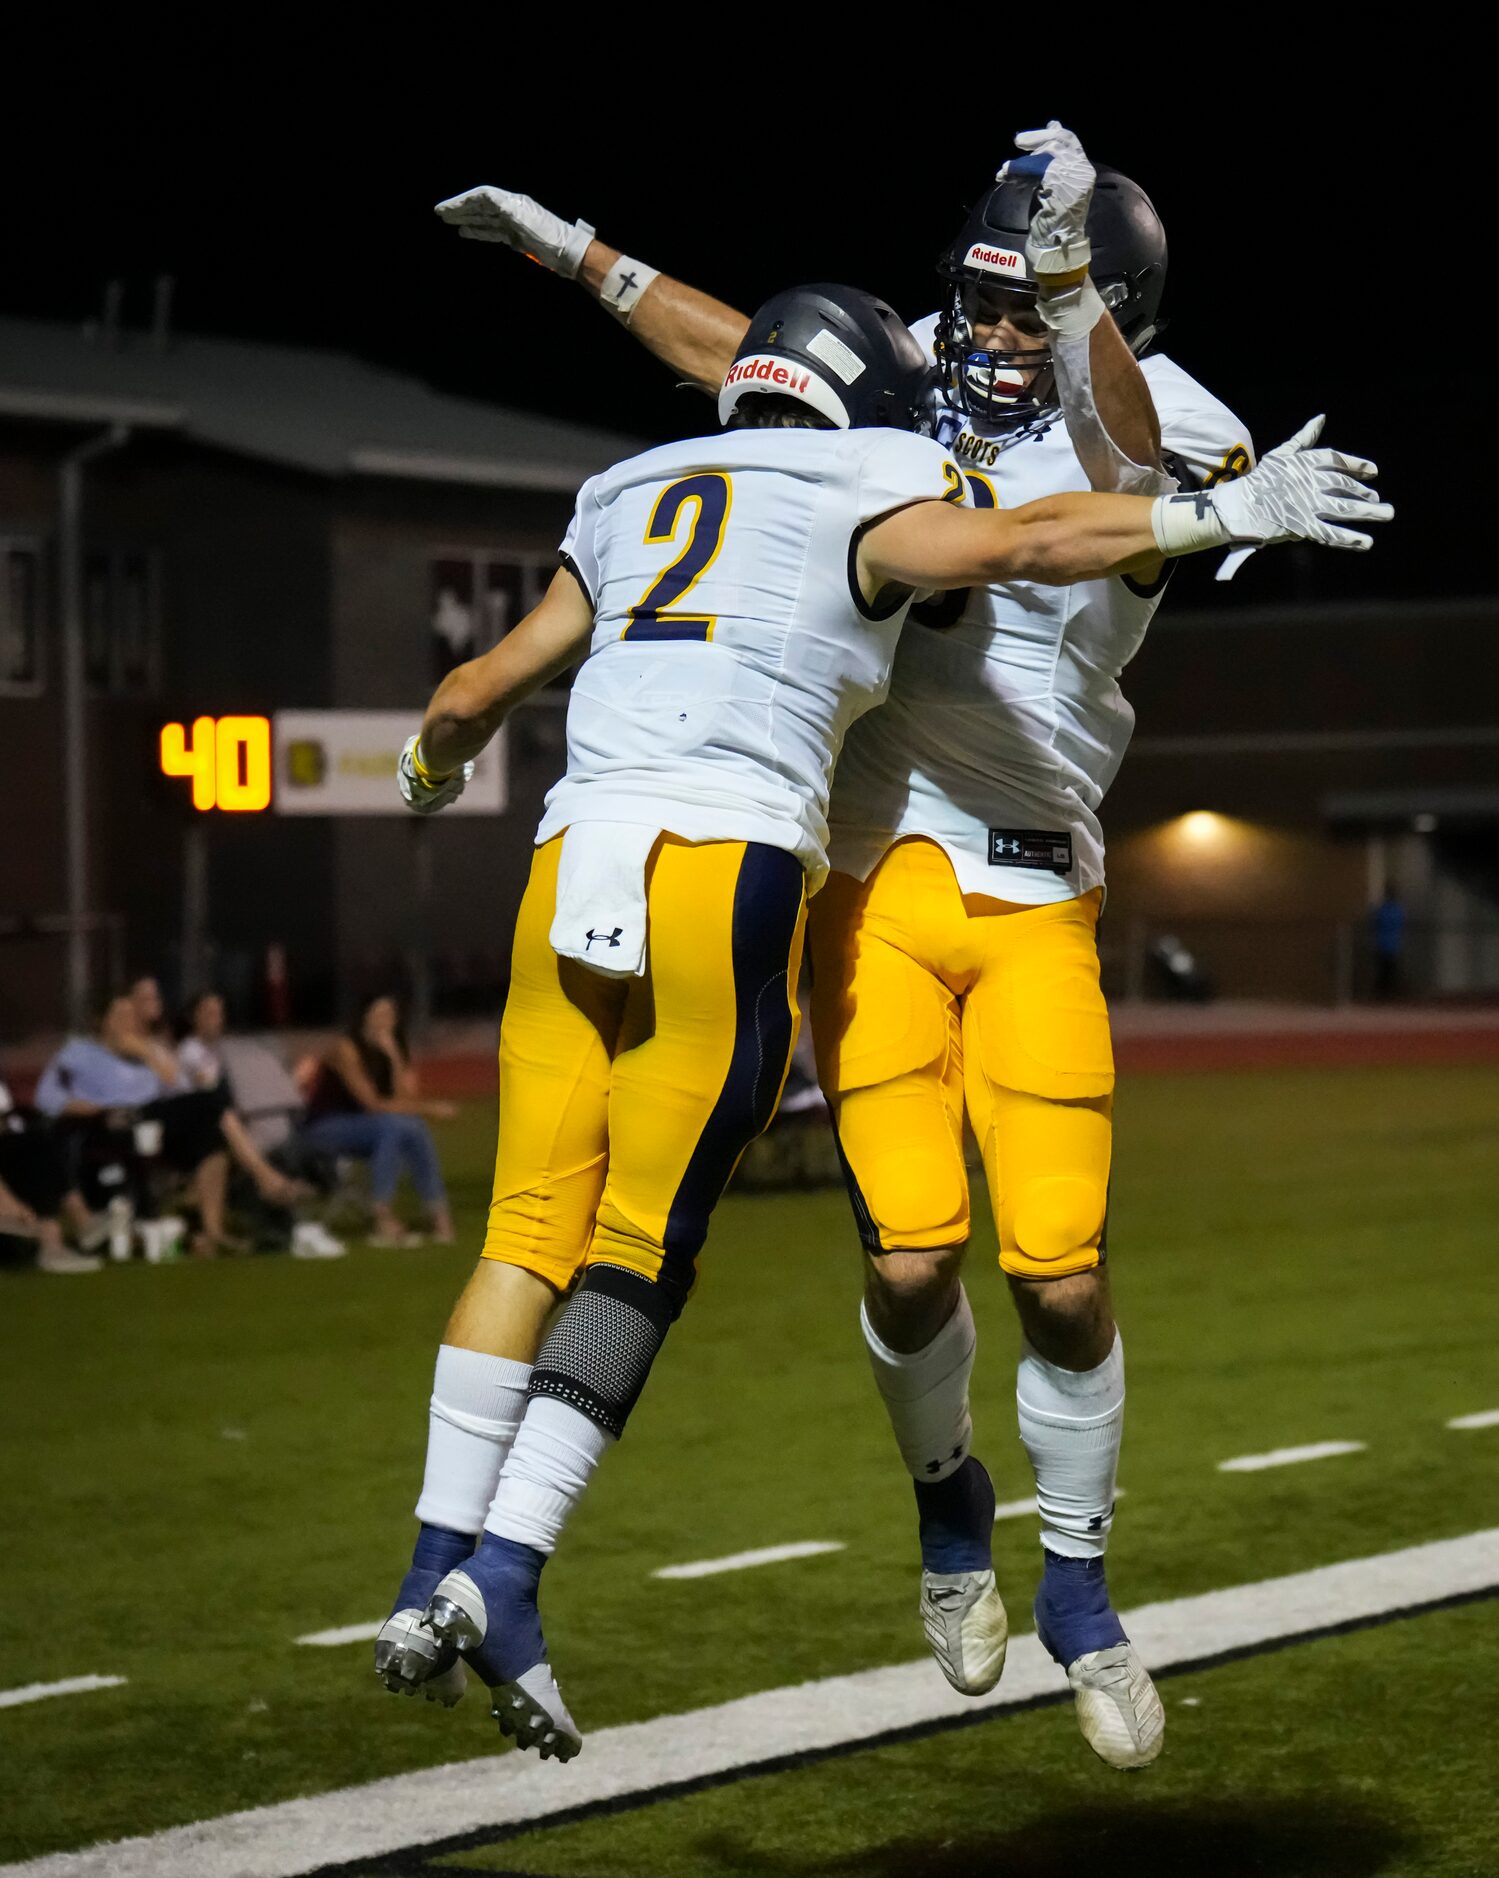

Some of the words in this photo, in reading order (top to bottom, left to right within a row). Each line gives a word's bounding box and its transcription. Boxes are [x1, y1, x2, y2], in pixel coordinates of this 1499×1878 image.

[971, 247, 1018, 268] Riddell
[724, 359, 812, 394] Riddell
[954, 432, 1000, 467] SCOTS
[942, 461, 966, 502] 2
[619, 472, 733, 642] 2
[160, 715, 271, 811] 40
